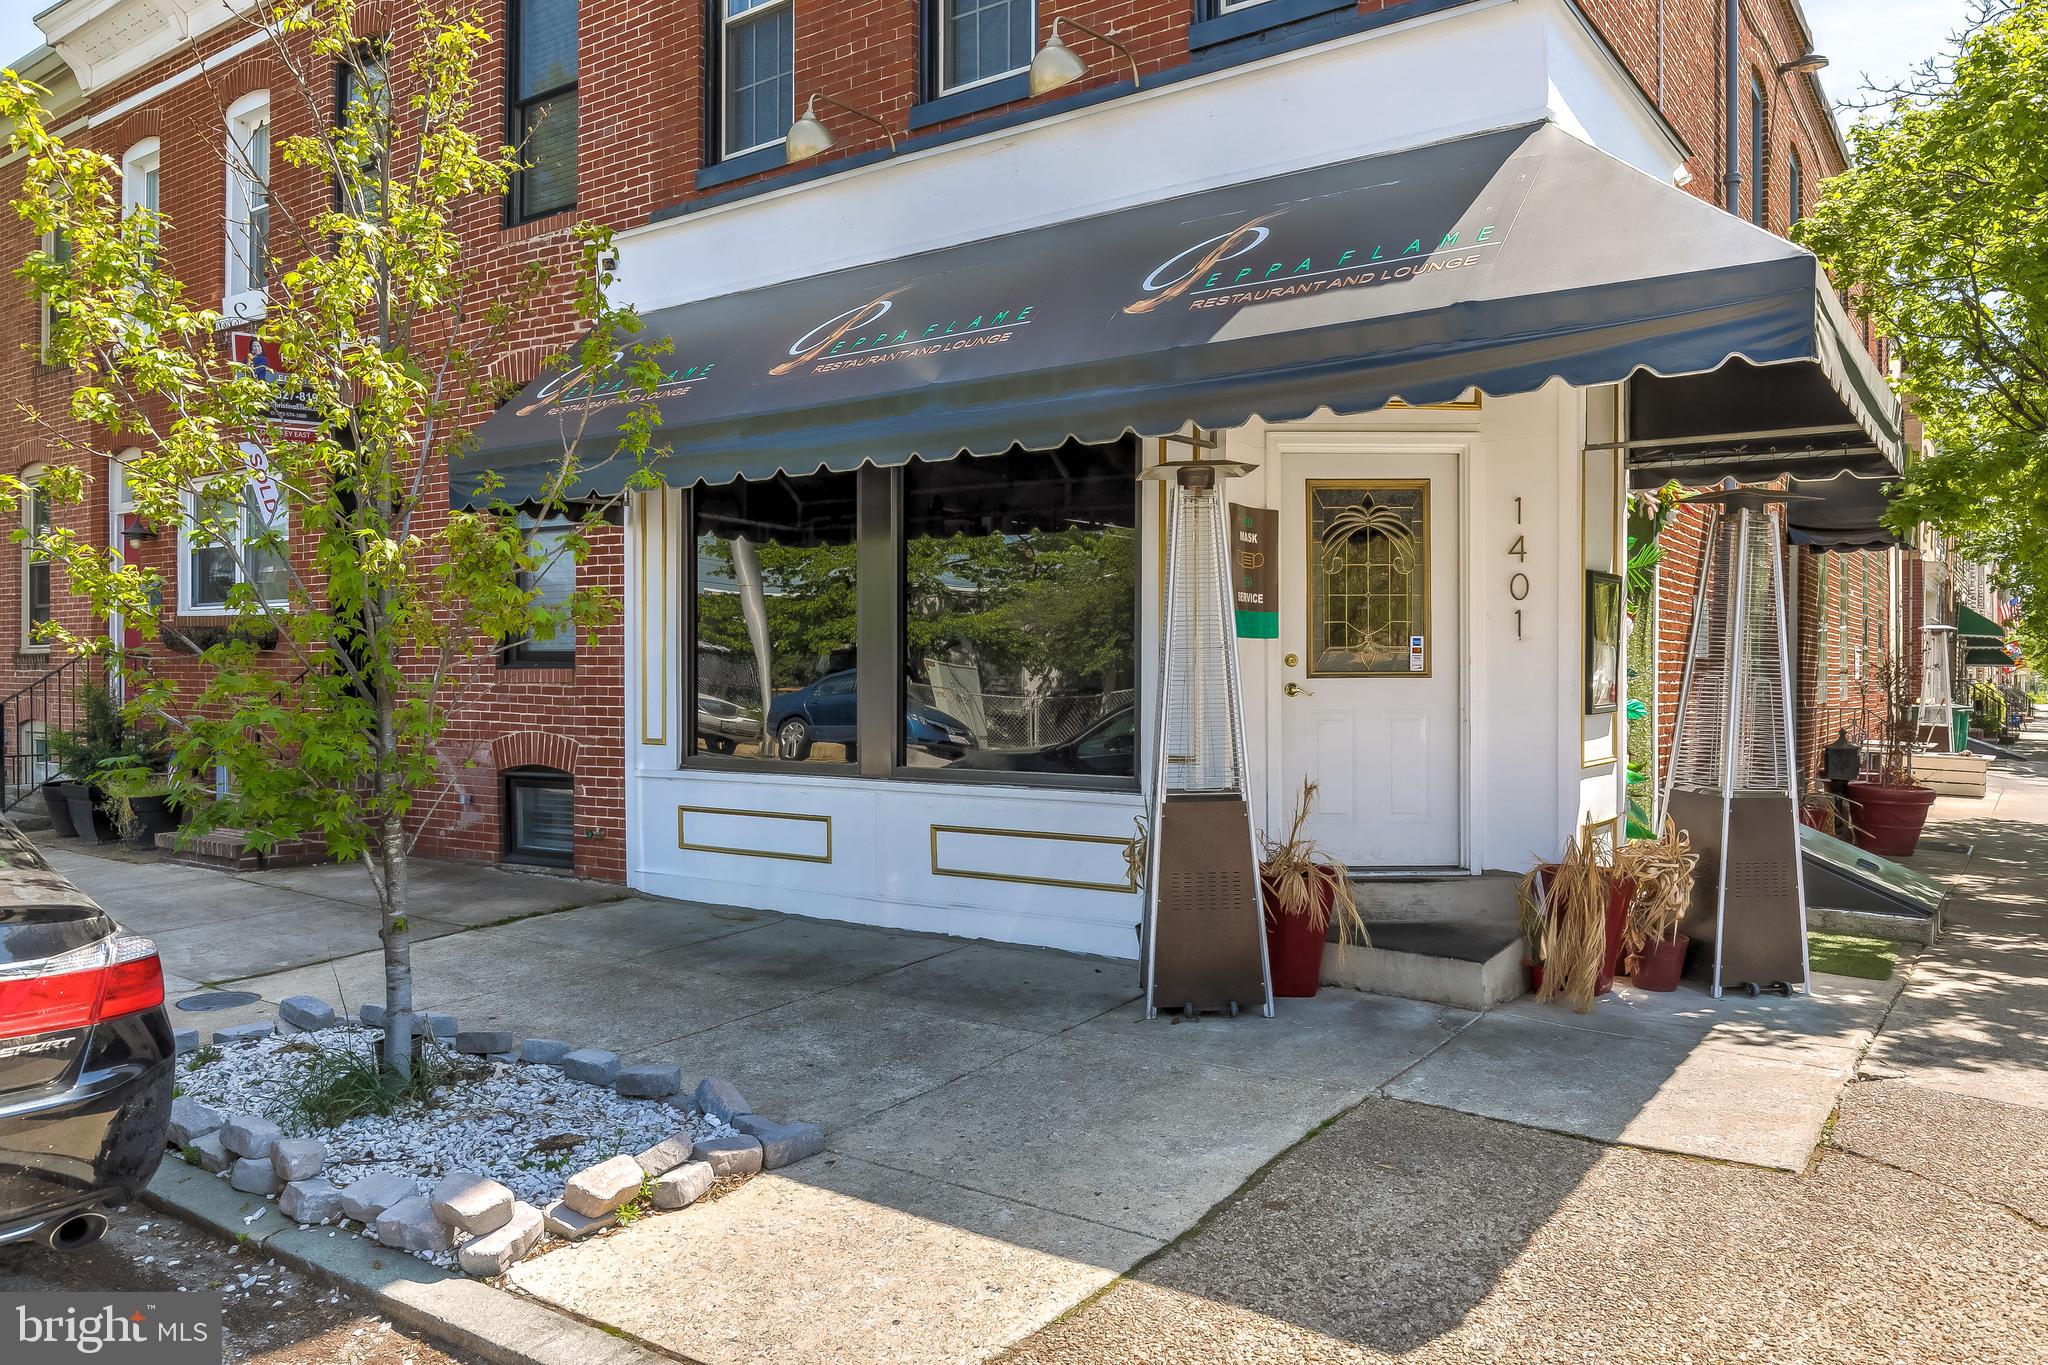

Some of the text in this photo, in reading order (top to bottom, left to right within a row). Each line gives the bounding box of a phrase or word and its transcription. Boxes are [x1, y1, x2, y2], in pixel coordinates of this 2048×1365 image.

[1337, 225, 1495, 268] FLAME
[1188, 254, 1481, 311] RESTAURANT AND LOUNGE
[923, 306, 1034, 337] FLAME
[811, 332, 1013, 375] RESTAURANT AND LOUNGE
[641, 386, 692, 401] LOUNGE
[250, 453, 277, 513] SOLD
[1240, 531, 1258, 544] MASK
[1508, 497, 1529, 637] 1401
[1237, 591, 1264, 604] SERVICE
[0, 1037, 76, 1058] SPORT
